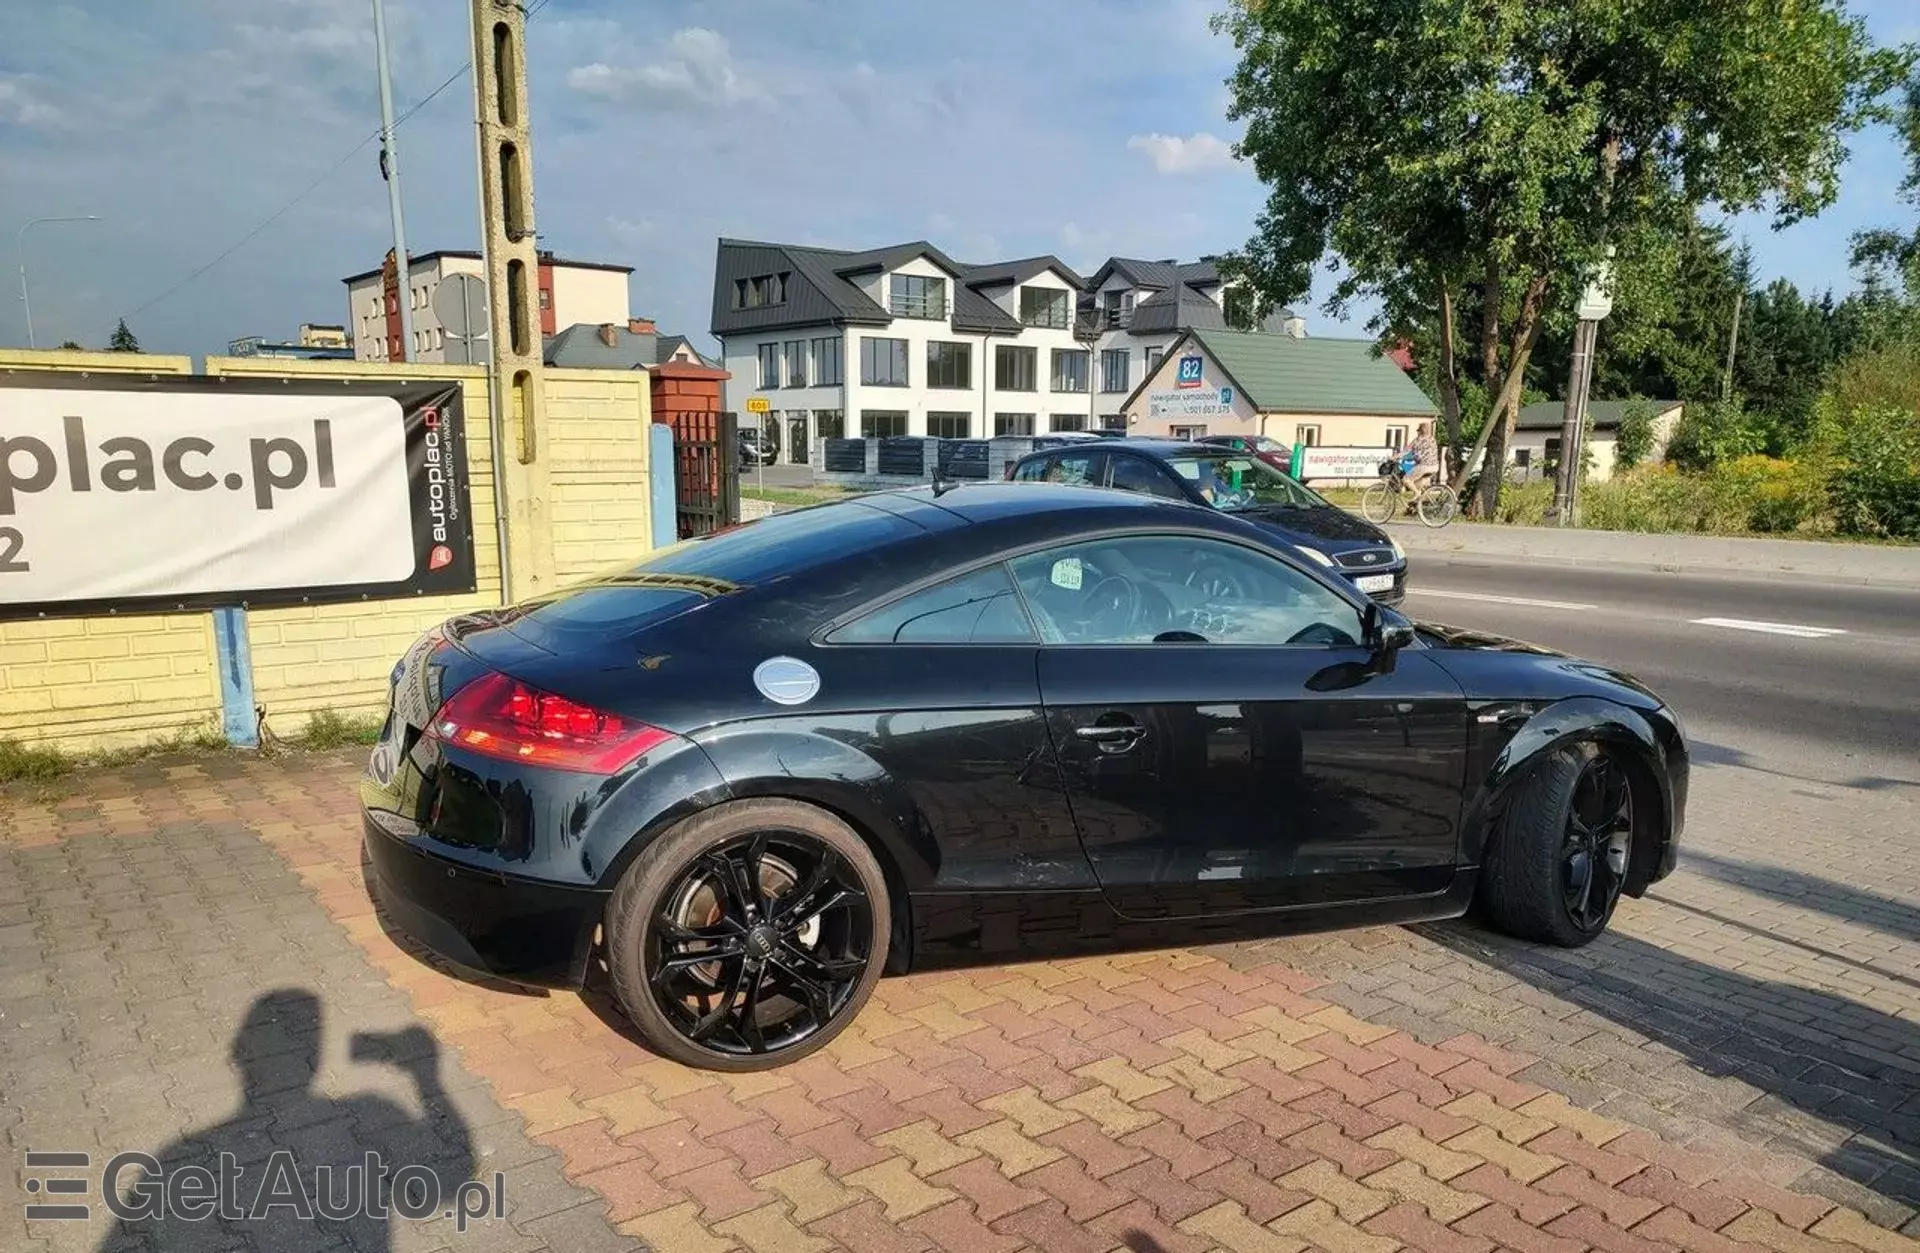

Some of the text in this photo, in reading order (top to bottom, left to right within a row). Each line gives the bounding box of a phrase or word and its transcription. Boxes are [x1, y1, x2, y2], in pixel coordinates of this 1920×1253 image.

[1182, 361, 1200, 378] 82
[420, 406, 447, 542] autoplac.pl
[445, 453, 455, 477] MOTO
